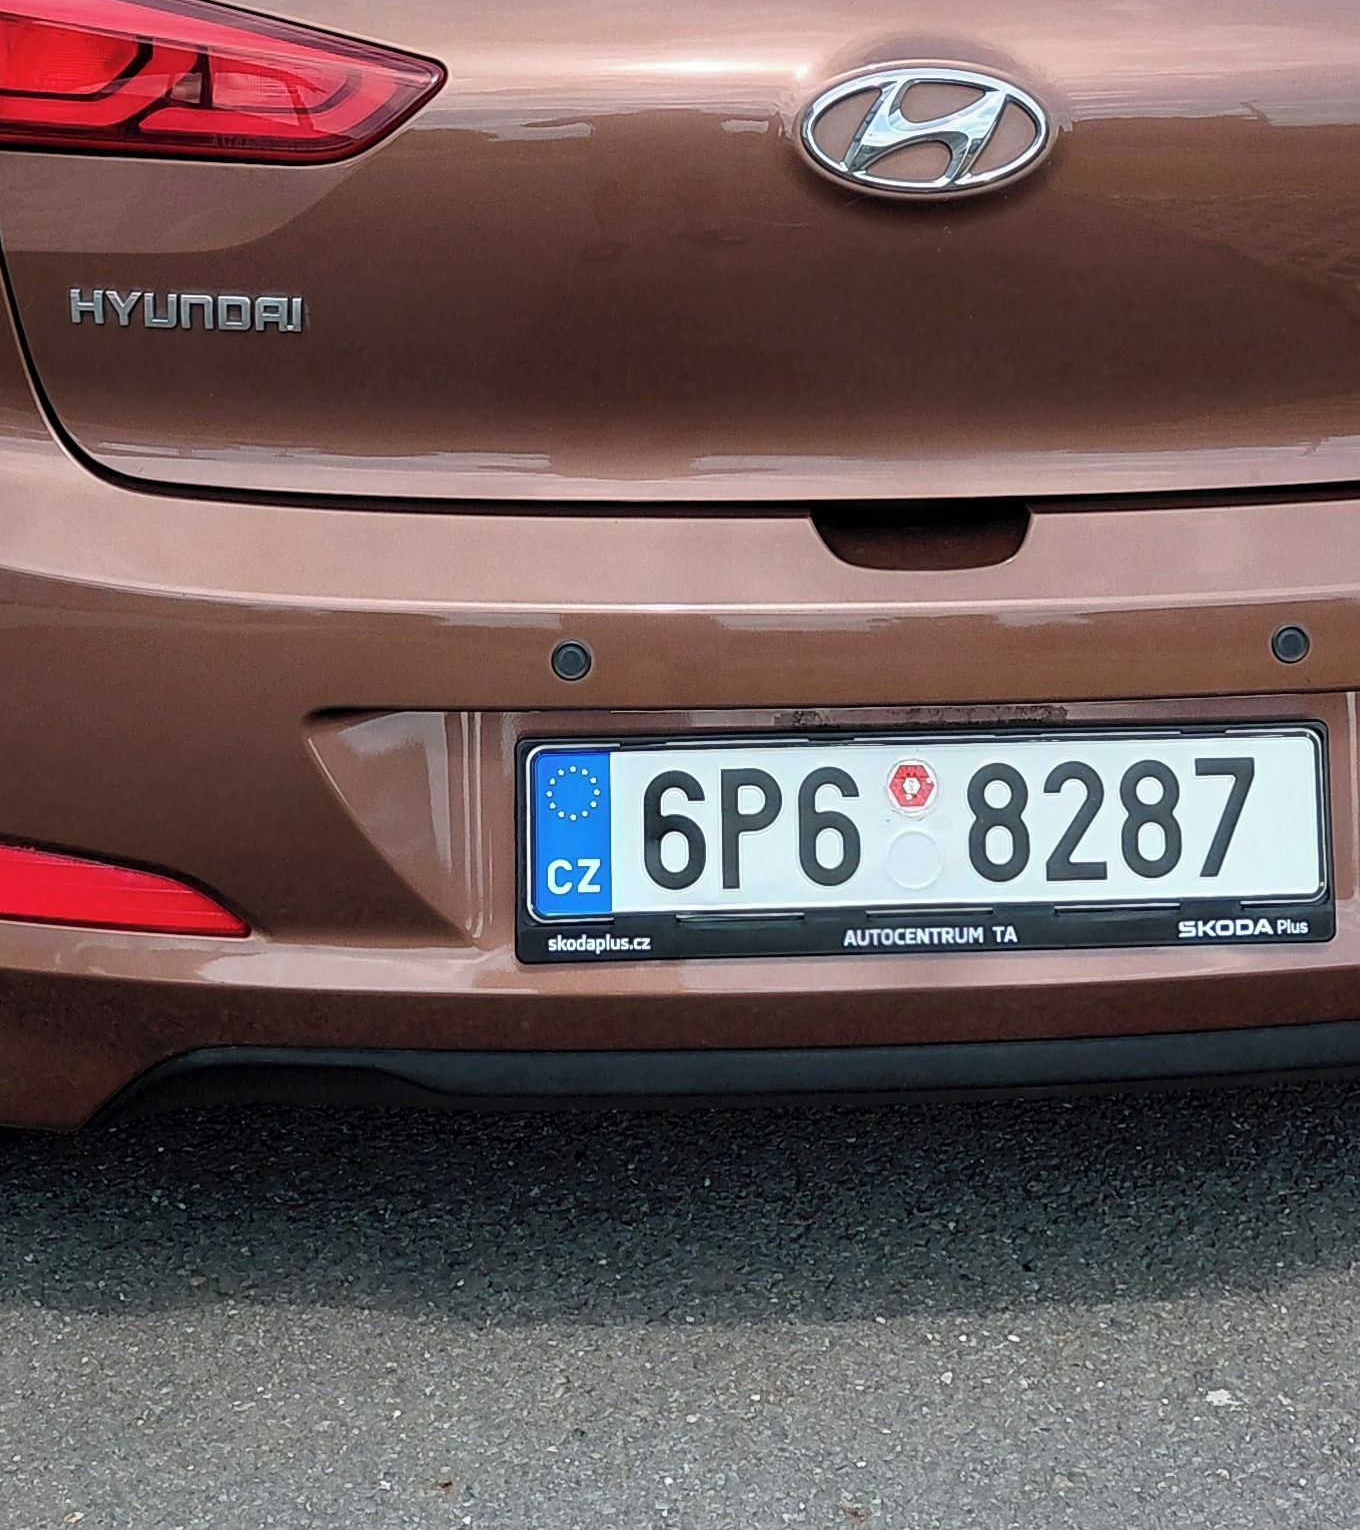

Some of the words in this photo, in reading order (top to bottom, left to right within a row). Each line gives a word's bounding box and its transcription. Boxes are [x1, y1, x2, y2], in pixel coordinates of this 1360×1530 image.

[70, 288, 302, 333] HYUNDAI
[643, 767, 861, 890] 6P6
[968, 757, 1255, 882] 8287
[547, 858, 601, 894] CZ
[843, 926, 984, 947] AUTOCENTRUM
[992, 925, 1018, 943] TA
[1178, 918, 1274, 938] SKODA
[1277, 918, 1309, 934] Plus
[548, 933, 651, 955] skodaplus.cz
